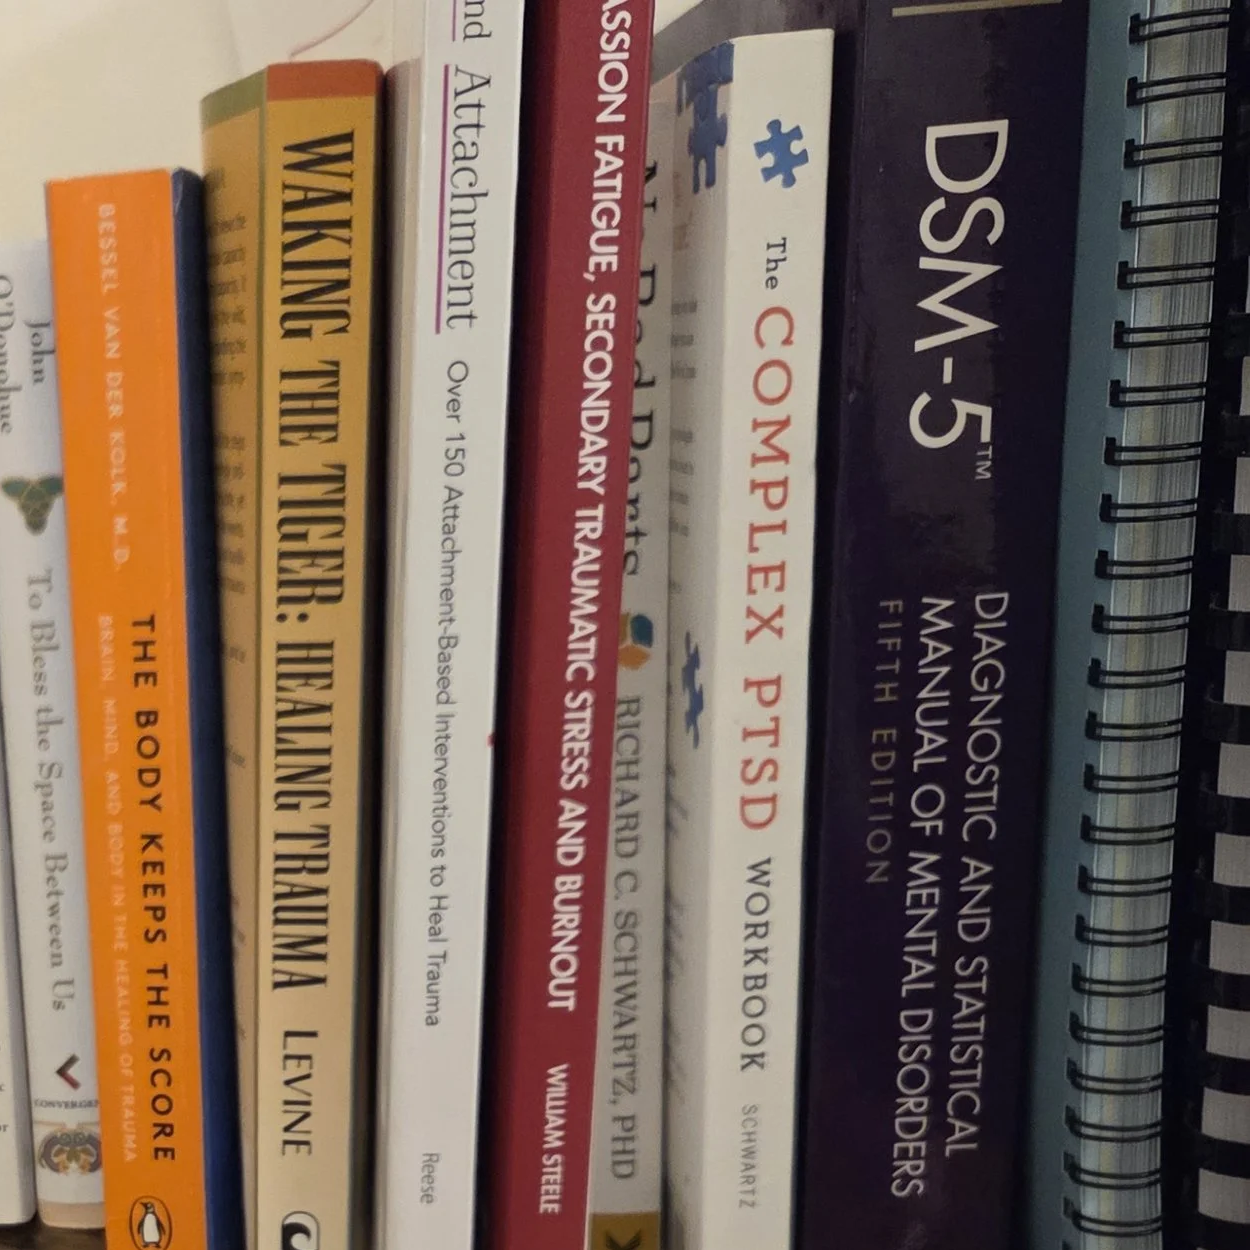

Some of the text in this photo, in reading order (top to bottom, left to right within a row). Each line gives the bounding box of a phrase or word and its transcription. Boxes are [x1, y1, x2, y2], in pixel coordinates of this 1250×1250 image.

[26, 317, 56, 384] John
[98, 203, 124, 420] BESSEL VAN DER
[446, 64, 492, 330] Attachment
[271, 128, 356, 993] WAKING THE TIGER: HEALING TRAUMA
[423, 360, 469, 1029] Over 150 Attachment-Based Interventions to Heal Trauma
[546, 134, 625, 1012] FATIGUE, SECONDARY TRAUMATIC STRESS AND BURNOUT
[738, 236, 796, 1072] The COMPLEX PTSD WORKBOOK
[864, 599, 904, 885] FIFTH EDITION
[26, 569, 77, 1012] To Bless the Space Between Us
[131, 614, 176, 1163] THE BODY KEEPS THE SCORE
[607, 695, 642, 1182] RICHARD C. SCHWARTZ, PHD
[890, 595, 957, 1200] MANUAL OF MENTAL DISORDERS
[944, 591, 1009, 1157] DIAGNOSTIC AND STATISTICAL
[280, 1028, 319, 1157] LEVINE
[419, 1151, 441, 1205] Reese
[538, 1062, 571, 1215] WILLIAM STEELE
[737, 1103, 759, 1210] SCHWARTZ
